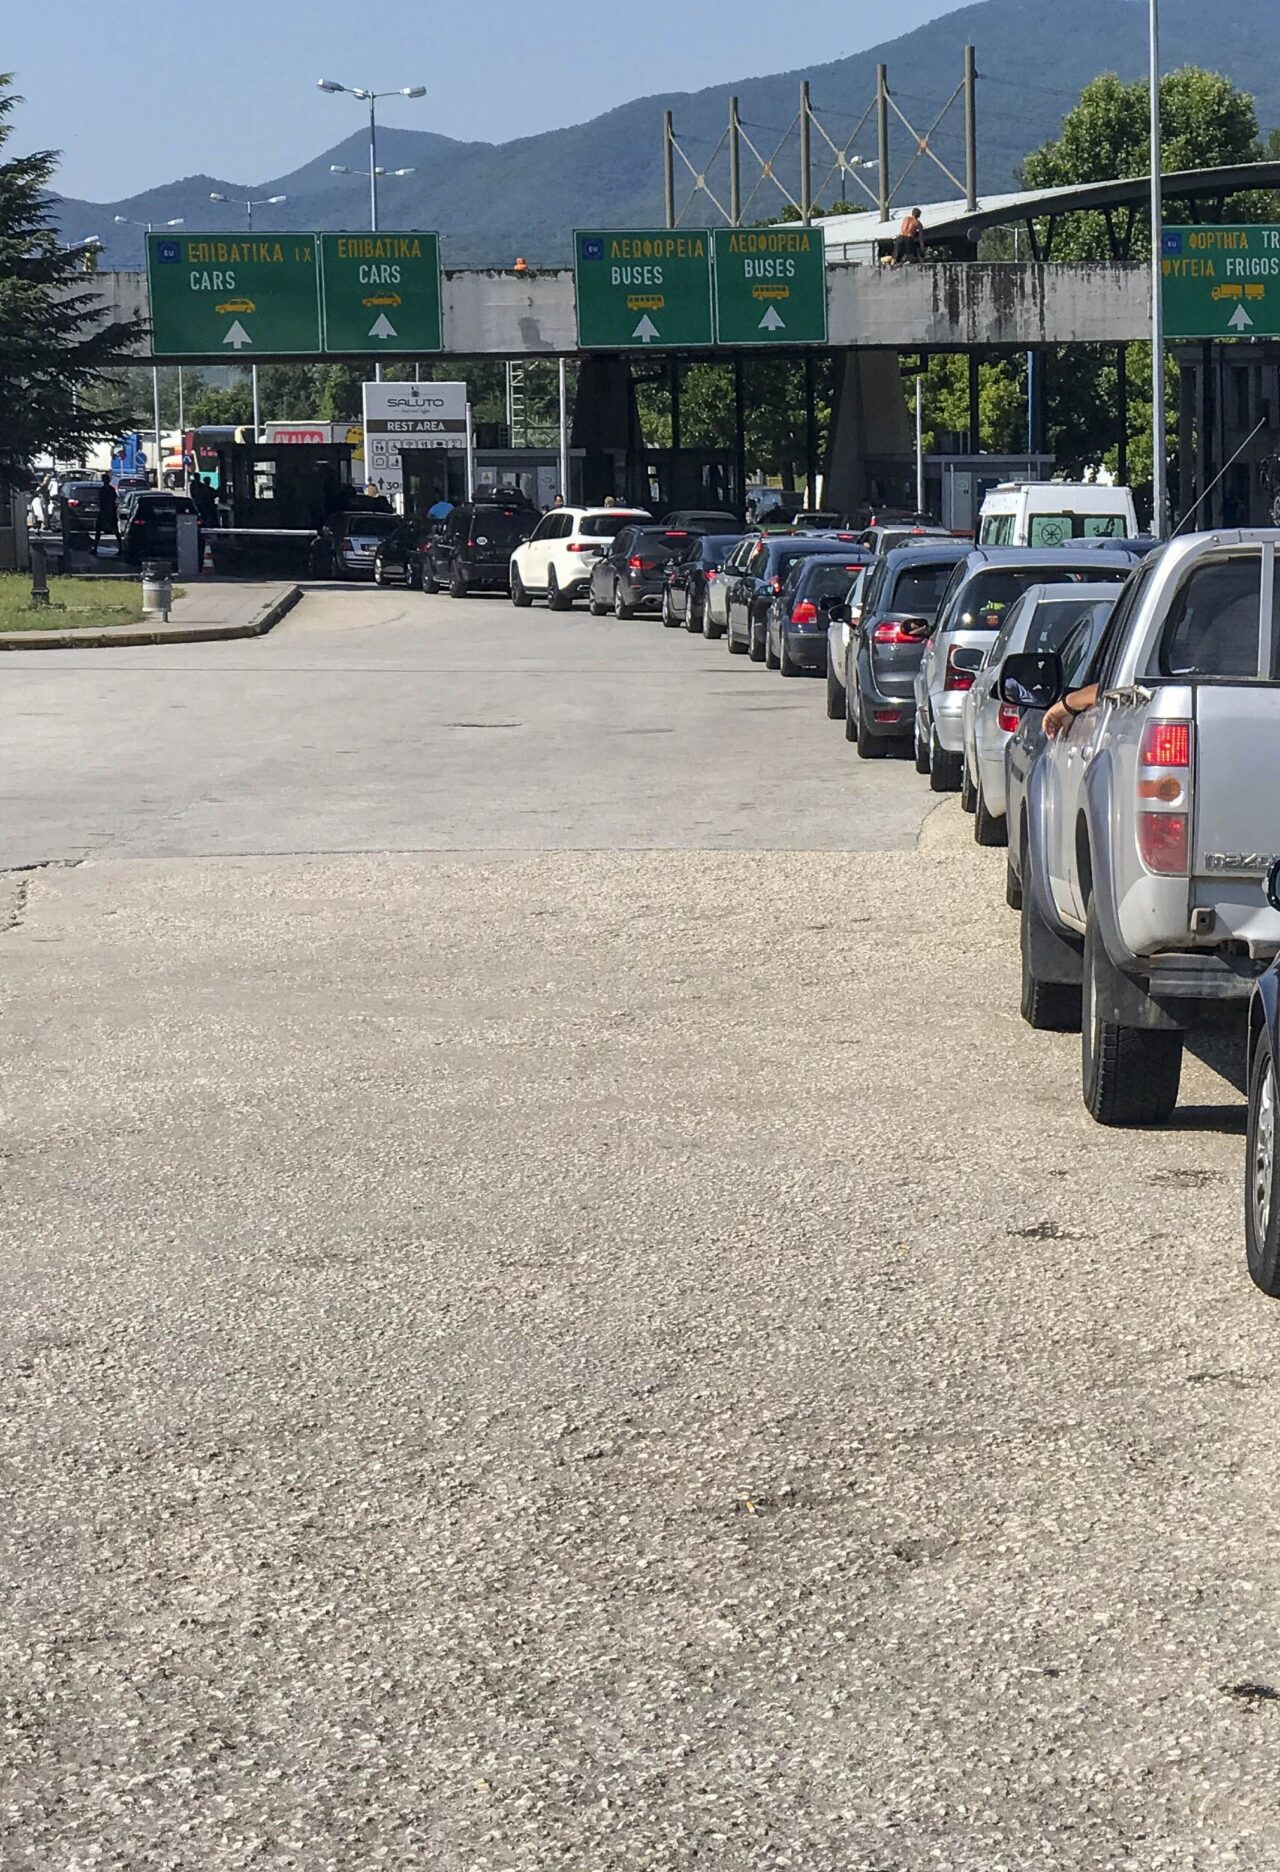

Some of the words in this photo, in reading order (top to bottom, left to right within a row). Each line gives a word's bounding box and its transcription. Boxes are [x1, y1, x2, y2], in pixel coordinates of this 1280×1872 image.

[610, 239, 704, 258] ΛΕΩΦΟΡΕΙΑ
[729, 233, 811, 253] ΛΕΩΦΟΡΕΙΑ
[1189, 232, 1249, 249] ΦΟΡΤΗΓΑ
[359, 264, 402, 284] CARS
[611, 266, 664, 286] BUSES
[744, 258, 796, 279] BUSES
[1226, 258, 1280, 277] FRIGOS
[190, 271, 236, 291] CARS
[387, 398, 445, 407] SALUTO
[387, 421, 414, 431] REST
[416, 421, 445, 431] AREA
[386, 481, 402, 490] 30
